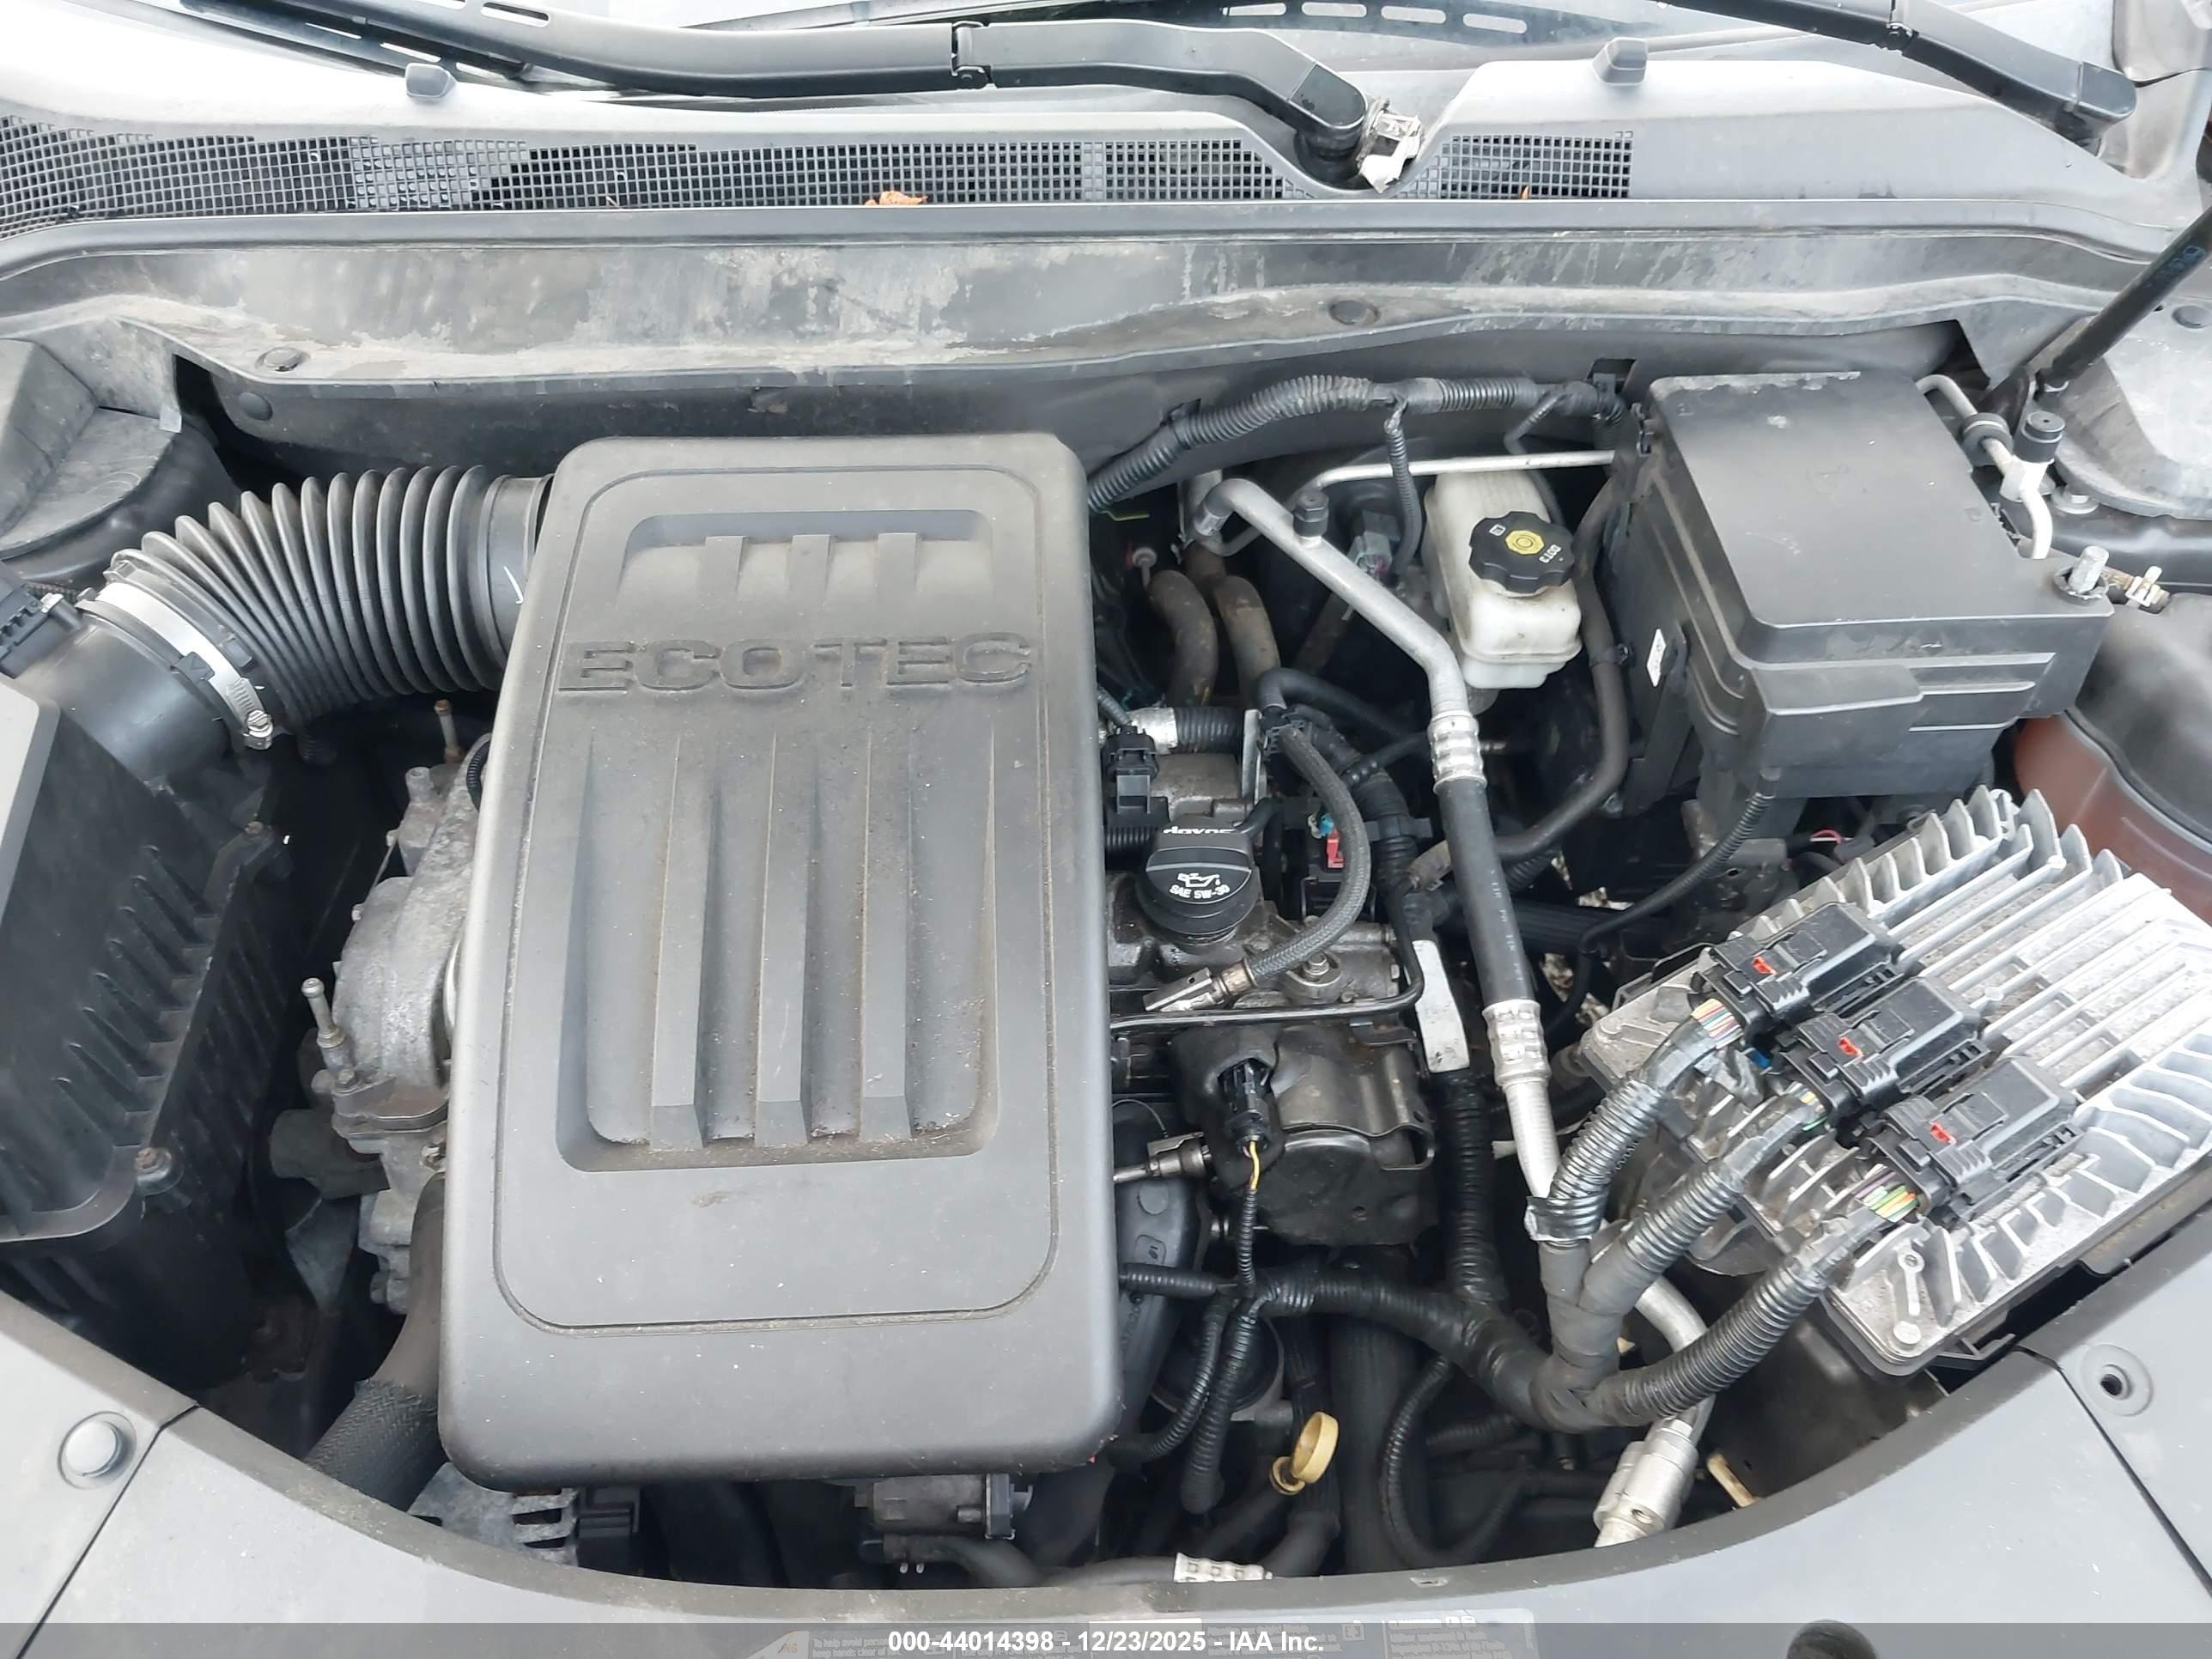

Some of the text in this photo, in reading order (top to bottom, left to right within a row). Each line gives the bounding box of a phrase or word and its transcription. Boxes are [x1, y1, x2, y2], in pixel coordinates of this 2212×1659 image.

[1539, 544, 1562, 563] DOT3
[558, 632, 1031, 691] ECOTEC
[1170, 884, 1231, 899] SAE 5W-30
